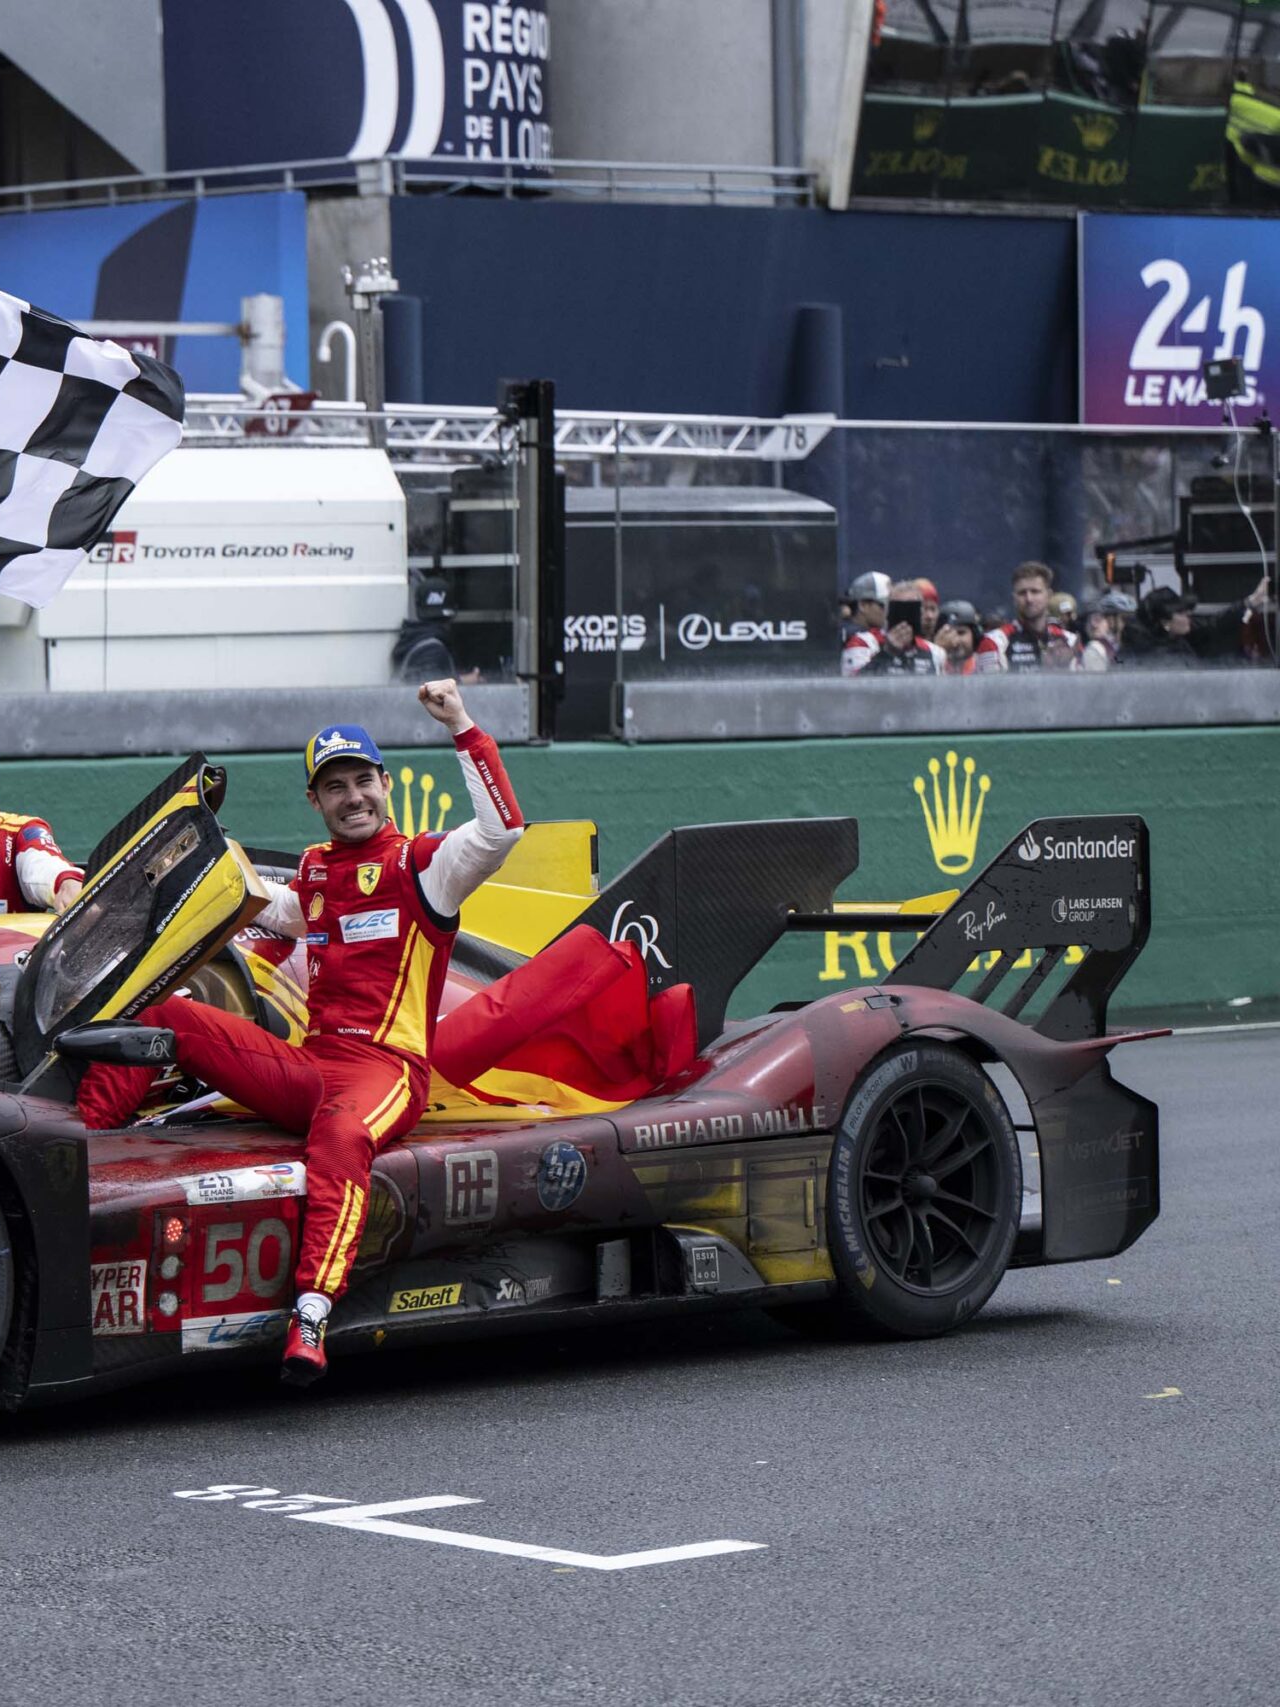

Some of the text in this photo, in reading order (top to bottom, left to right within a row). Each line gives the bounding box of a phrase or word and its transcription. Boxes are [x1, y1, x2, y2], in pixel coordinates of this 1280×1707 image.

[464, 58, 543, 115] PAYS
[465, 114, 494, 140] DE
[1129, 258, 1265, 371] 24h
[1124, 375, 1166, 406] LE
[89, 541, 354, 563] GR TOYOTA GAZOO Racing
[714, 620, 808, 641] LEXUS
[315, 743, 361, 763] MICHELIN
[478, 759, 512, 821] RICHARD MILLE
[1044, 835, 1136, 860] Santander
[156, 857, 217, 935] @FerrariHypercar
[1069, 897, 1123, 909] LARS LARSEN
[344, 911, 396, 931] WEC
[1069, 911, 1095, 922] GROUP
[634, 1105, 827, 1148] RICHARD MILLE
[200, 1188, 234, 1197] LE MANS
[834, 1145, 860, 1262] MICHELIN
[202, 1218, 292, 1303] 50
[92, 1266, 141, 1290] YPER
[94, 1290, 140, 1328] AR
[397, 1286, 454, 1310] Sabelt
